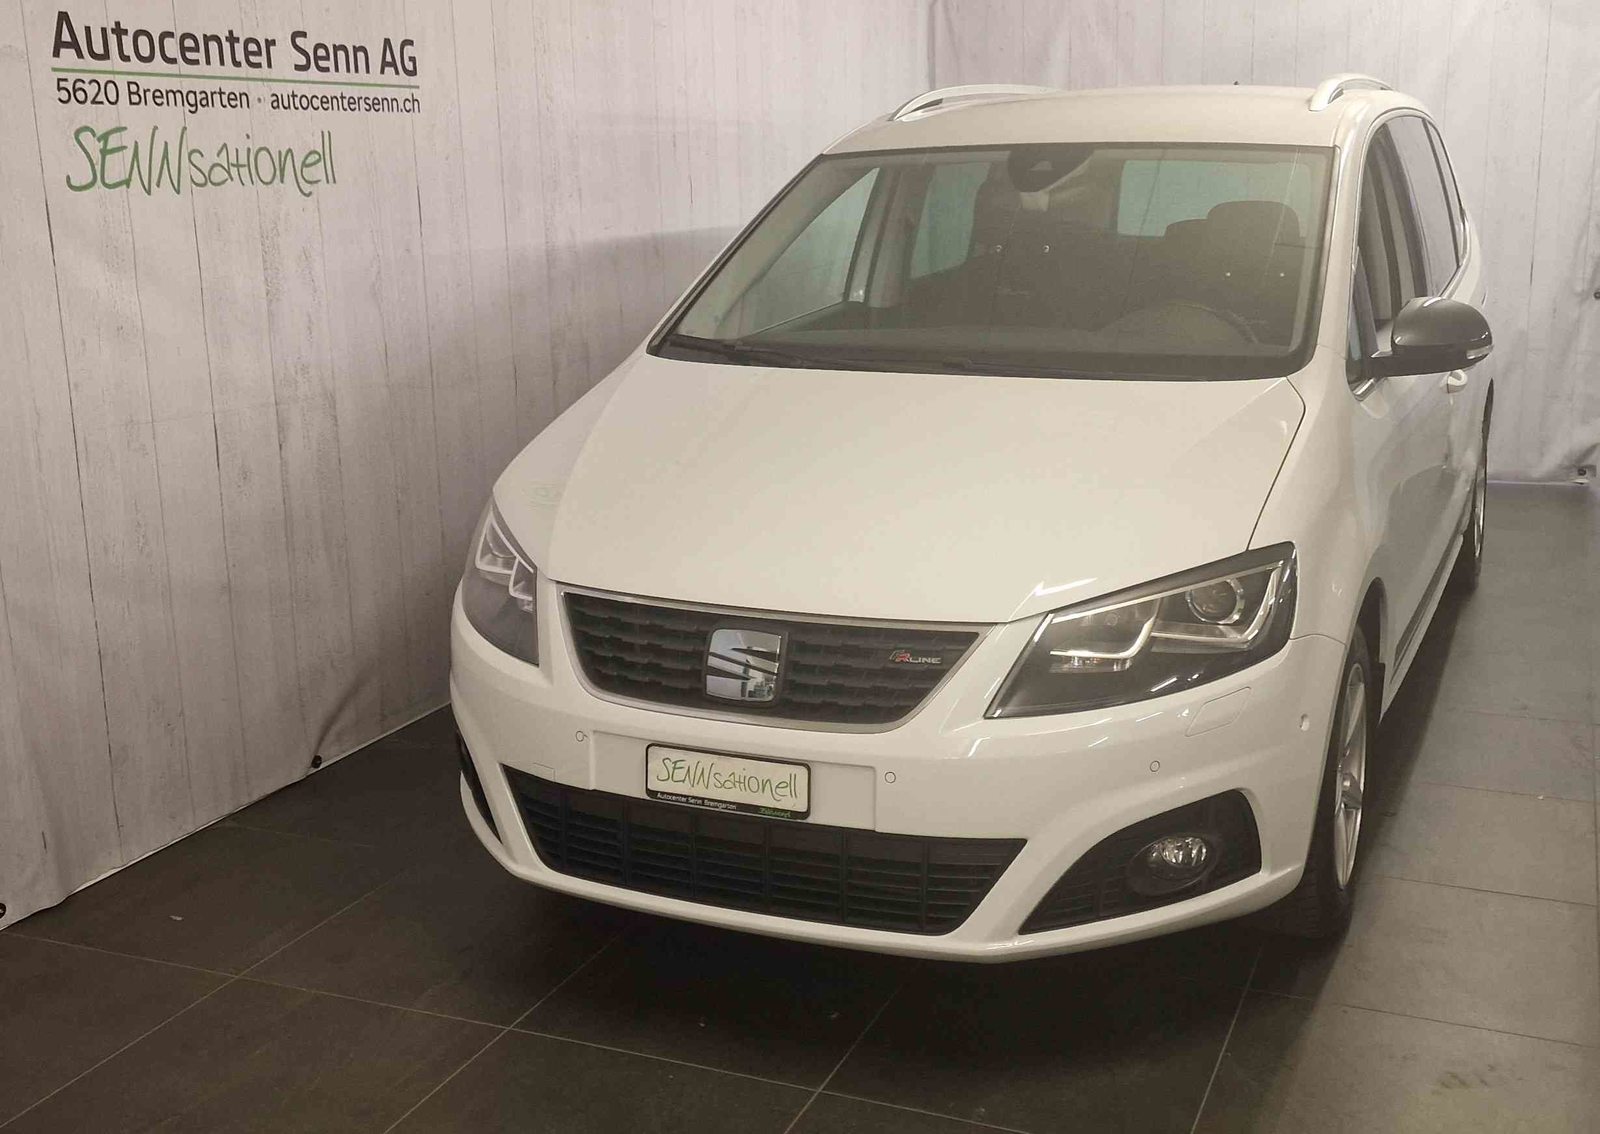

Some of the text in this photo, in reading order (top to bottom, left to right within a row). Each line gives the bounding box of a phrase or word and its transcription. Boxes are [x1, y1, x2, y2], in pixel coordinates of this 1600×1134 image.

[52, 10, 419, 77] Autocenter Senn AG
[56, 77, 421, 115] 5620 Bremgarten autocentersenn.ch
[66, 124, 337, 198] SENNsationell
[657, 758, 798, 801] SENNsationell
[657, 792, 737, 810] Autocenter Senn Bremgarten
